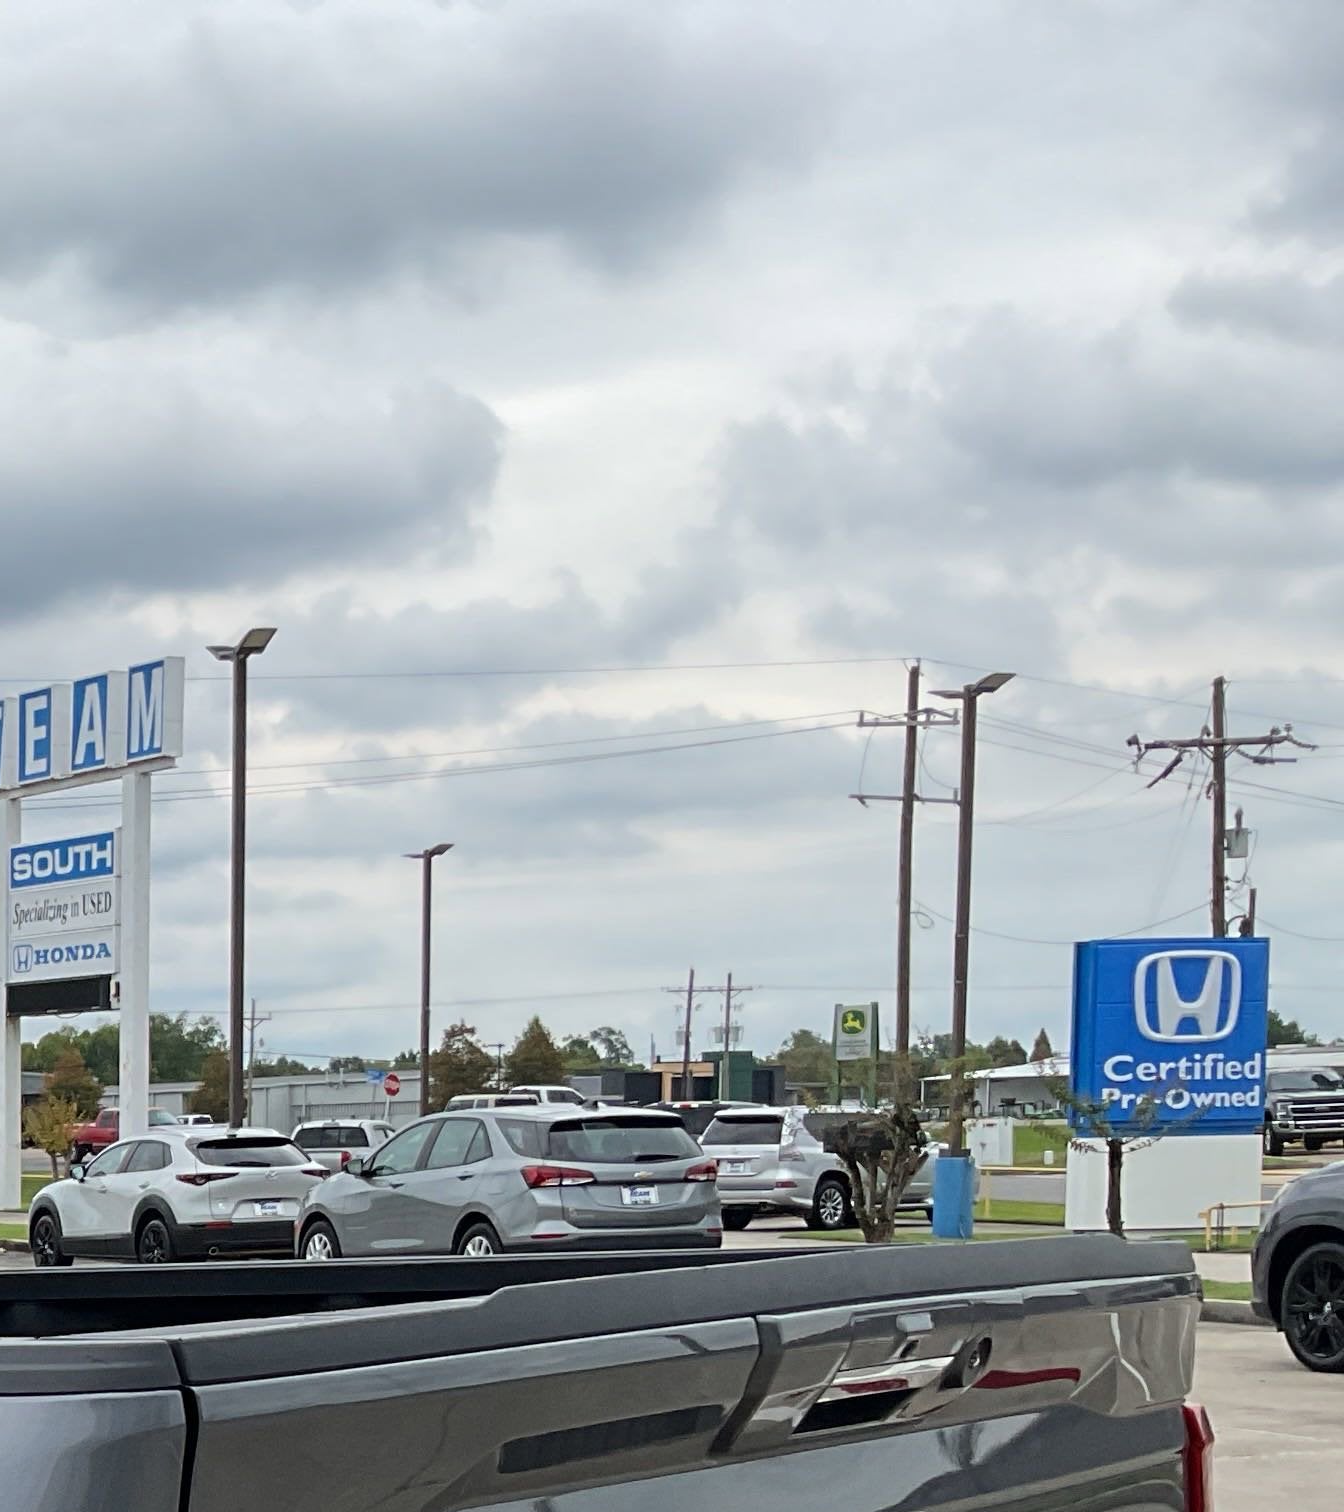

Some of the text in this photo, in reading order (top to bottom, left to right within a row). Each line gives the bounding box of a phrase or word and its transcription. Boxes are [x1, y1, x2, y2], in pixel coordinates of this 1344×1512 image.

[13, 840, 112, 880] SOUTH
[13, 891, 112, 930] Specializing in USED
[34, 942, 112, 965] HONDA
[1103, 1052, 1262, 1082] Certified
